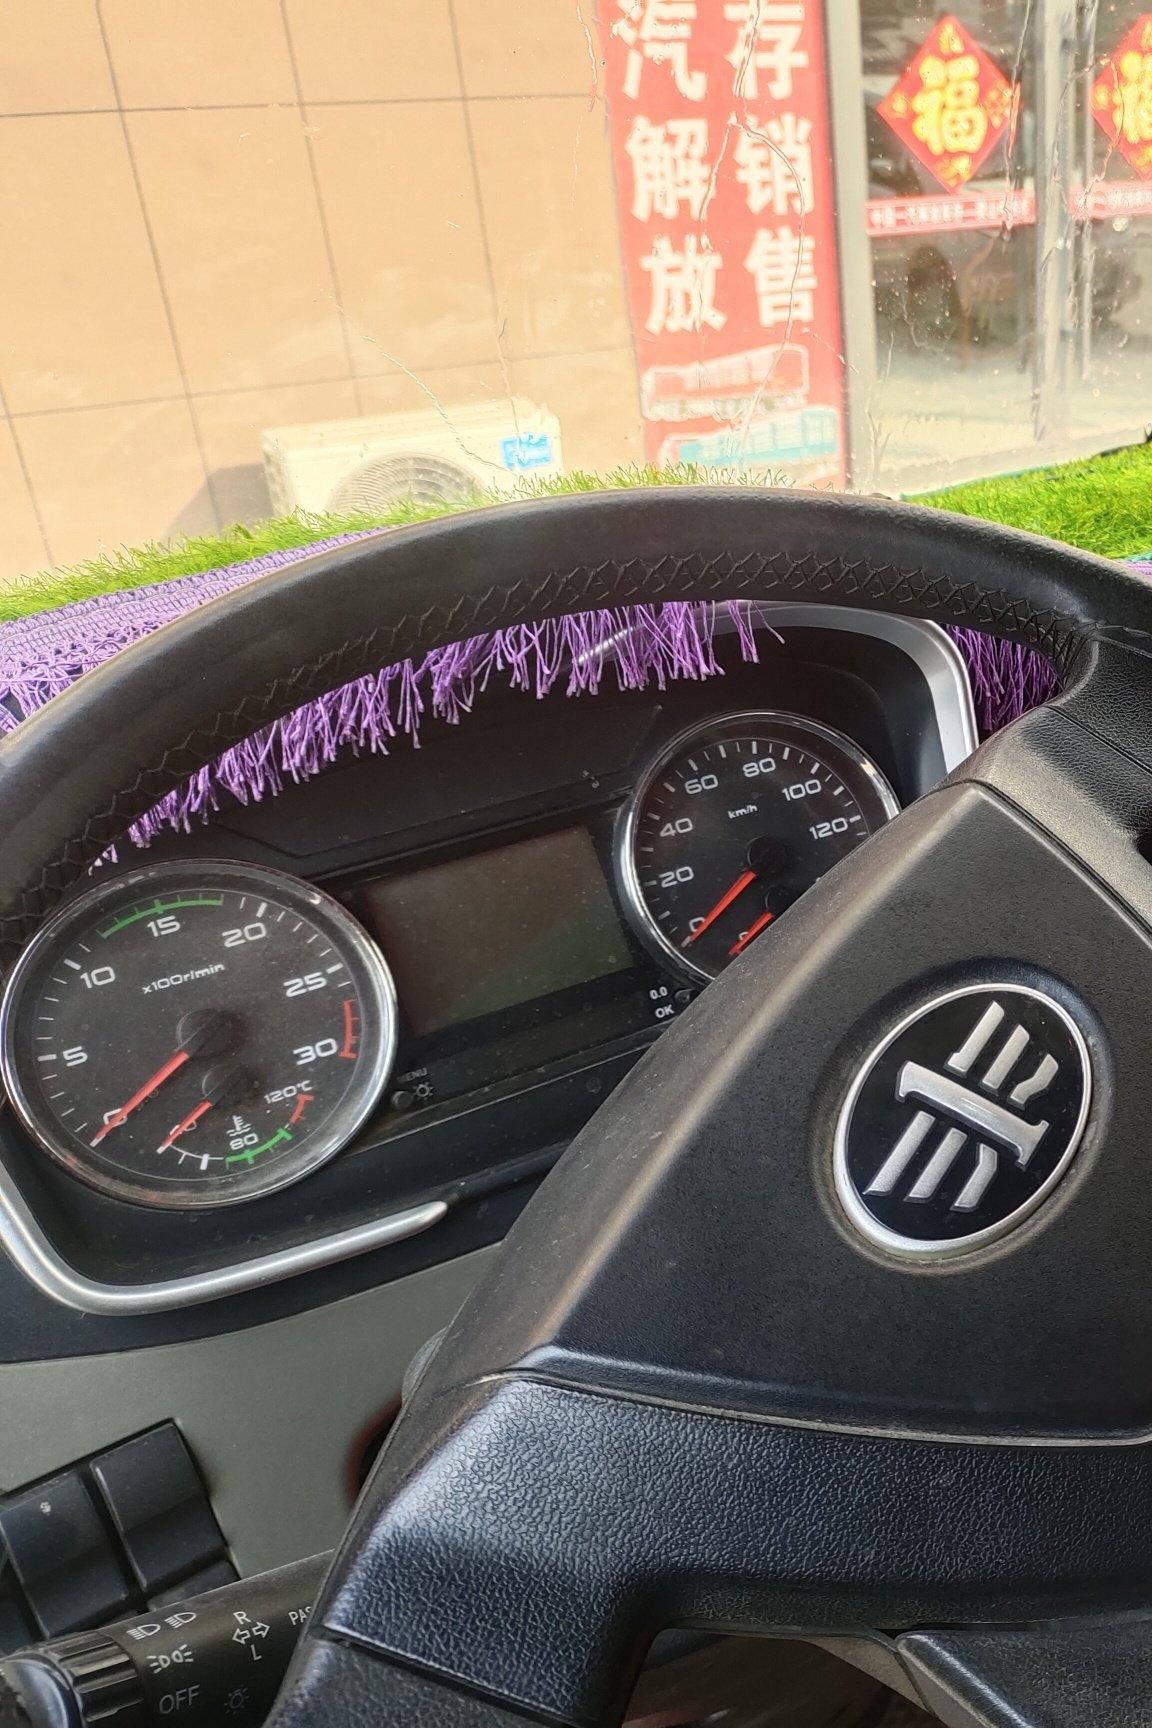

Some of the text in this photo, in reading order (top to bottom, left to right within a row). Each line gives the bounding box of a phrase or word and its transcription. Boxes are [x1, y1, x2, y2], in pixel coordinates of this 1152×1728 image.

[911, 54, 989, 156] 福
[742, 757, 776, 778] 80
[684, 774, 719, 795] 60
[781, 779, 822, 802] 100
[727, 804, 758, 820] km/h
[659, 817, 694, 838] 40
[809, 817, 848, 840] 120
[659, 866, 694, 888] 20
[146, 915, 181, 938] 15
[222, 922, 267, 948] 20
[79, 966, 116, 989] 10
[283, 971, 328, 998] 25
[649, 986, 668, 1000] 0.0
[655, 1004, 675, 1018] OK
[62, 1046, 88, 1067] 5
[293, 1038, 339, 1065] 30
[229, 1134, 259, 1151] 80
[233, 1611, 252, 1625] R
[250, 1645, 262, 1661] L
[158, 1684, 200, 1714] OFF
